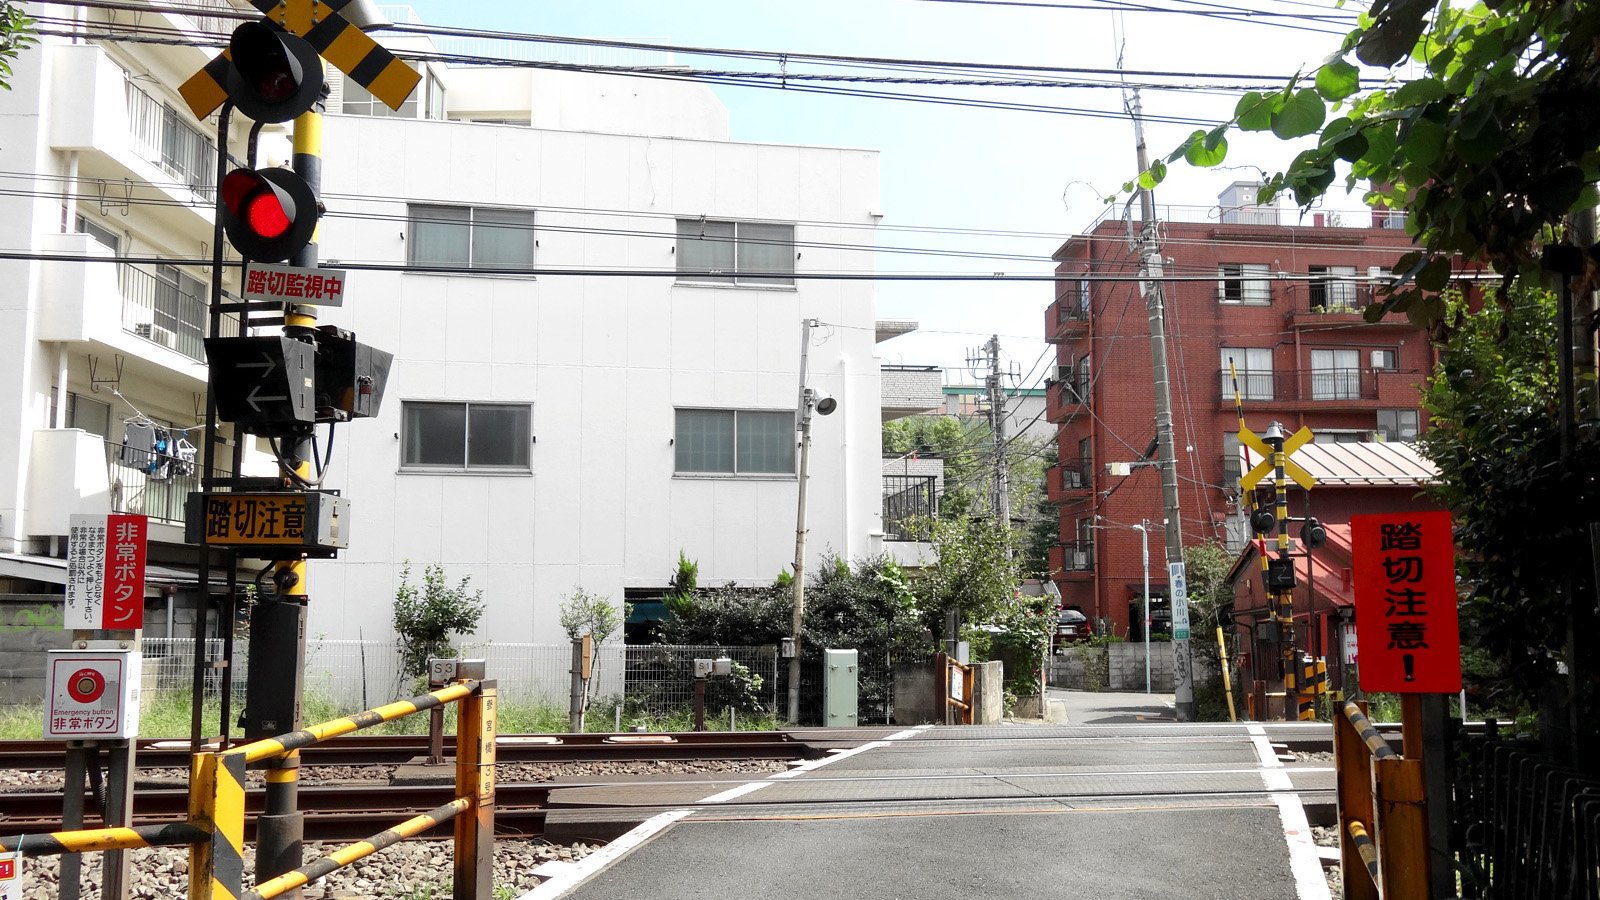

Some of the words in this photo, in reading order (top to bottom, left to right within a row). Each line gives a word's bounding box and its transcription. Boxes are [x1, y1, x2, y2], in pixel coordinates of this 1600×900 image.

[247, 270, 342, 300] 踏切監視中
[207, 500, 305, 539] 踏切注意
[114, 522, 139, 622] 非常ボタン
[54, 716, 116, 730] 非常ボタン
